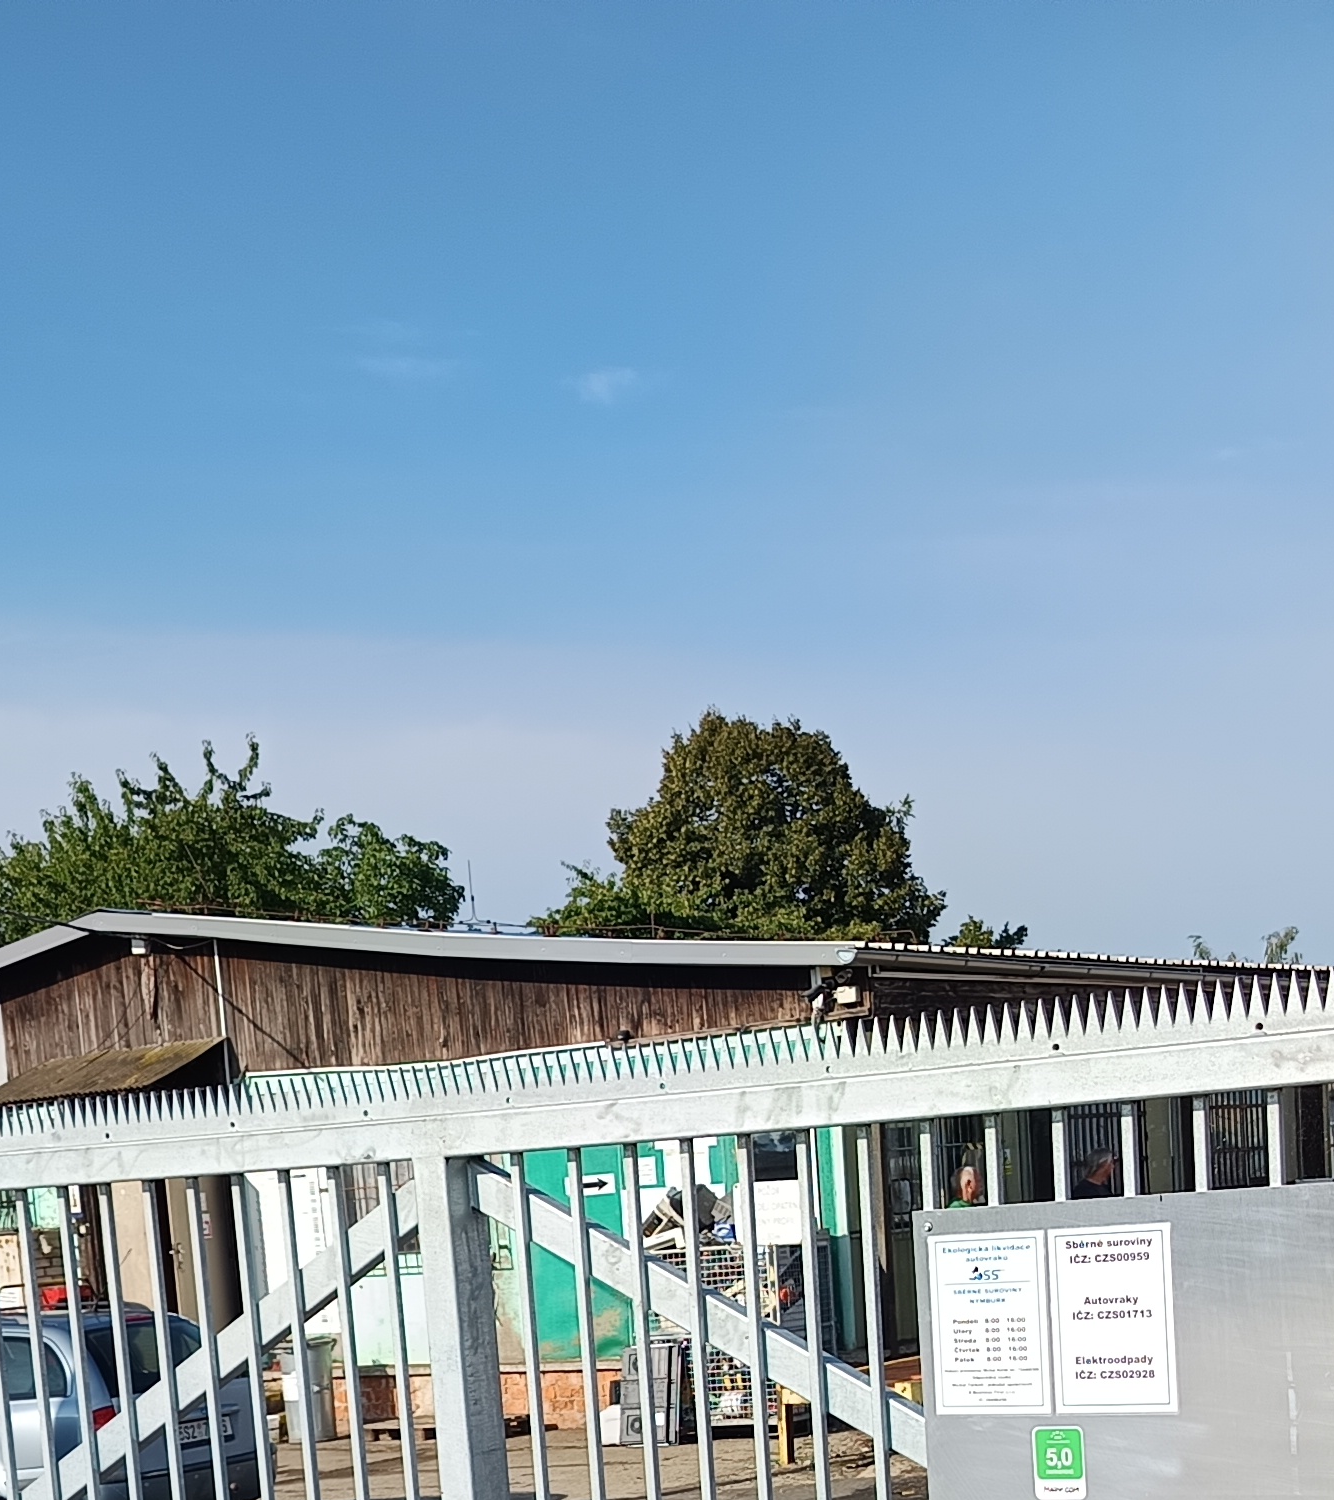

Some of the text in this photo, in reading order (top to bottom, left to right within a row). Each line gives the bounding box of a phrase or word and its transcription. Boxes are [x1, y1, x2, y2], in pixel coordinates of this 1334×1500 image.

[991, 1243, 1031, 1252] likvidace
[1106, 1237, 1153, 1248] suroviny
[1069, 1252, 1150, 1264] IČZ: CZS00959
[1083, 1294, 1139, 1306] Autovraky
[1072, 1309, 1152, 1320] IČZ: CZS01713
[1075, 1354, 1154, 1366] Elektroodpady
[1075, 1369, 1155, 1380] IČZ: CZS02928
[1046, 1447, 1073, 1469] 5,0
